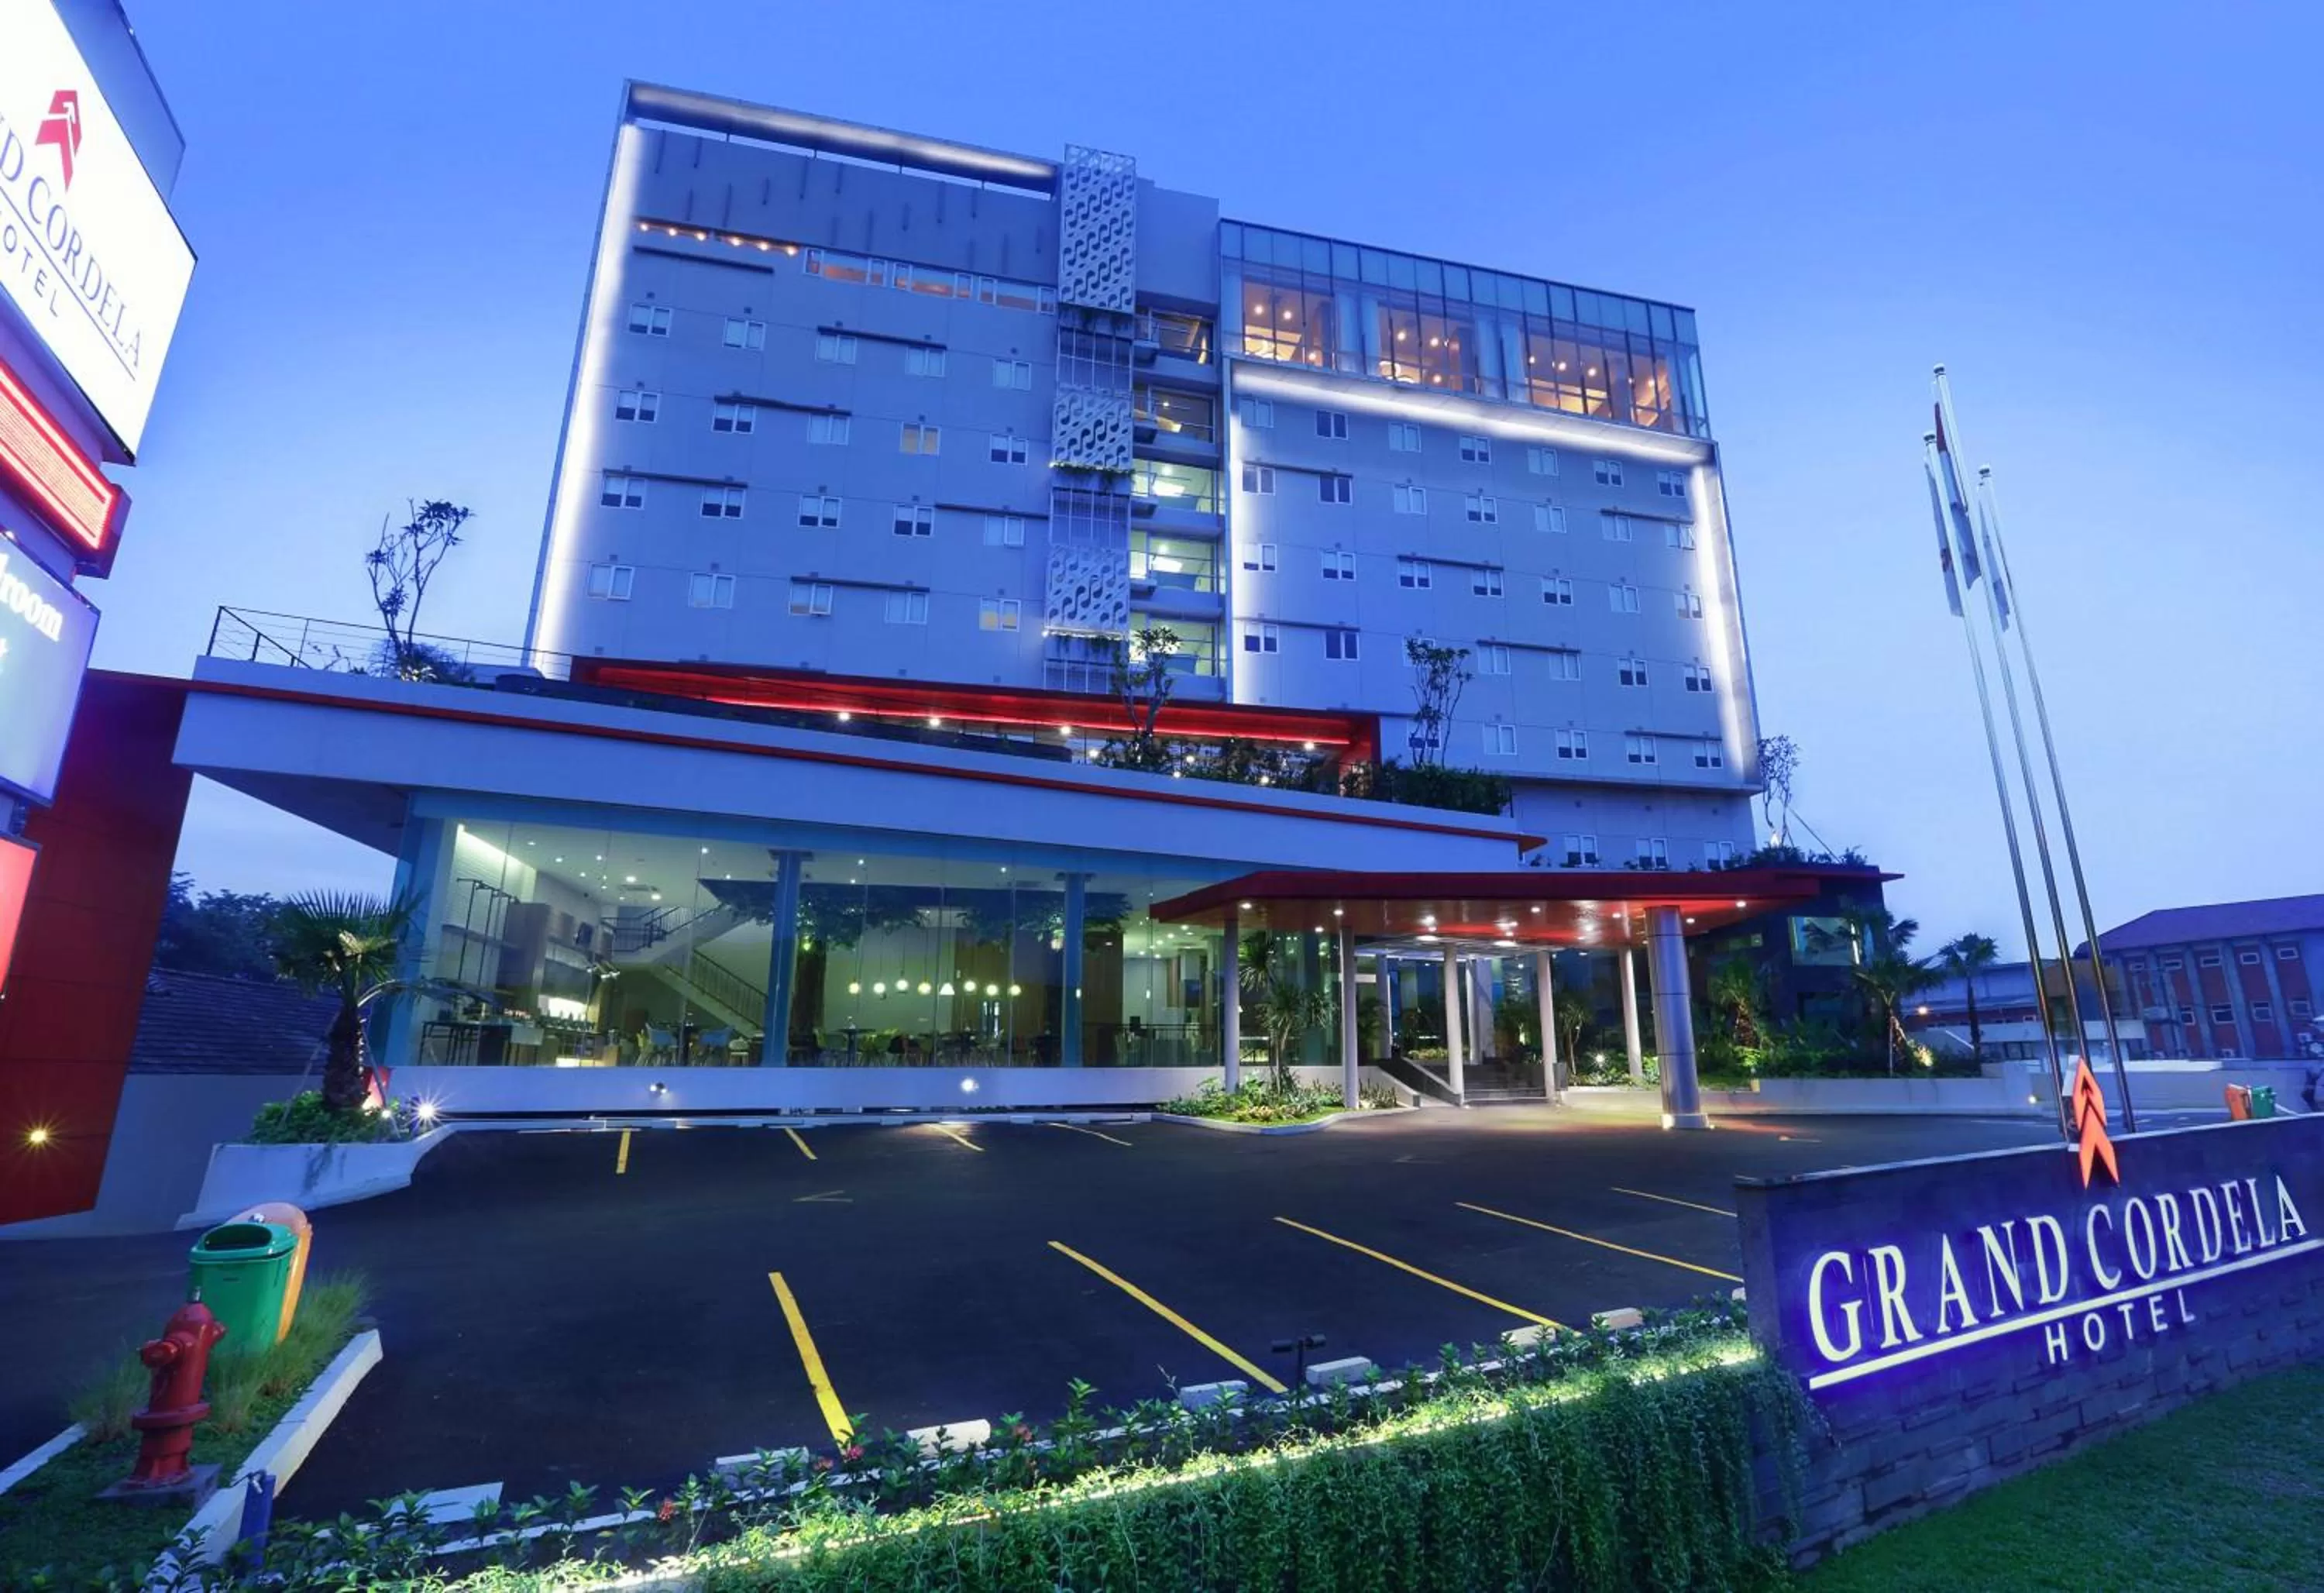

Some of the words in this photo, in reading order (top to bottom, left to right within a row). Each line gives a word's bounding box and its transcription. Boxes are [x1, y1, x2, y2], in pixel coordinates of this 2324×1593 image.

[0, 212, 58, 318] OTEL
[28, 176, 140, 367] CORDELA
[1809, 1214, 2068, 1362] GRAND
[2086, 1175, 2308, 1290] CORDELA
[2045, 1289, 2195, 1364] HOTEL
